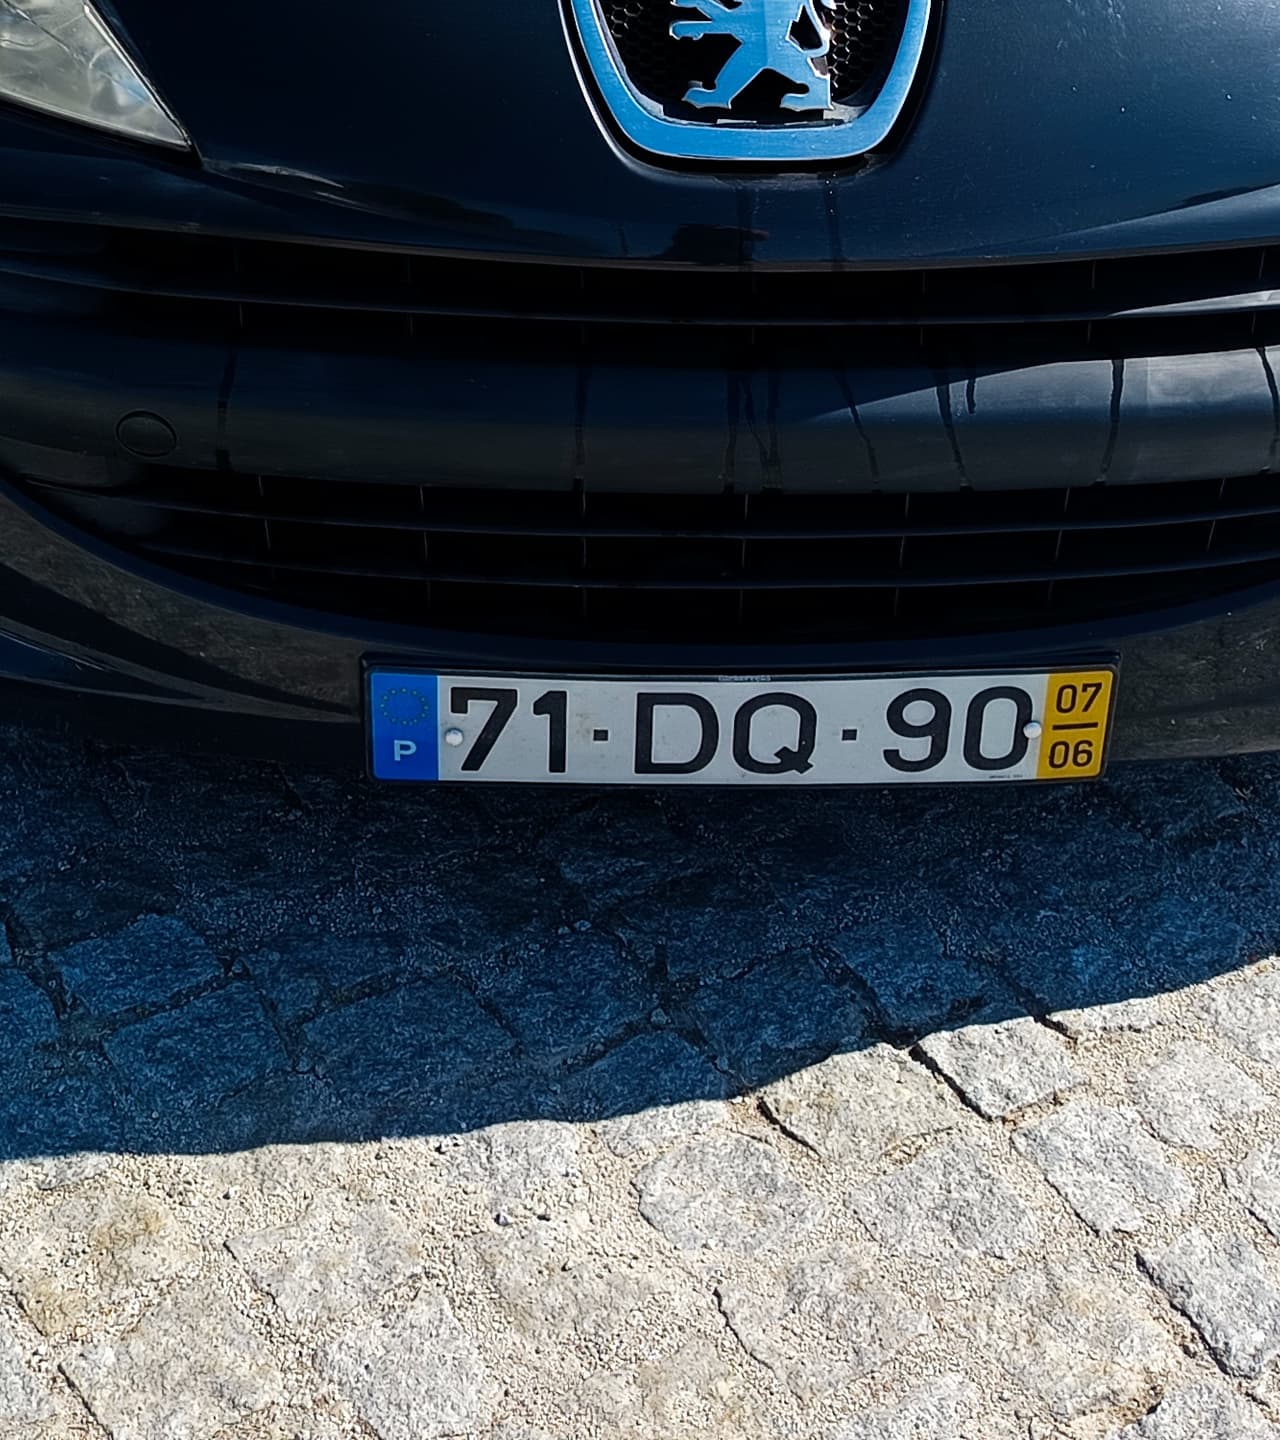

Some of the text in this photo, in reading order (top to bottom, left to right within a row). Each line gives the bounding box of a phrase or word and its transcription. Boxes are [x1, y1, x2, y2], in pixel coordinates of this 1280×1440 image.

[1056, 682, 1102, 713] 07
[393, 739, 417, 761] P
[1048, 739, 1094, 769] 06
